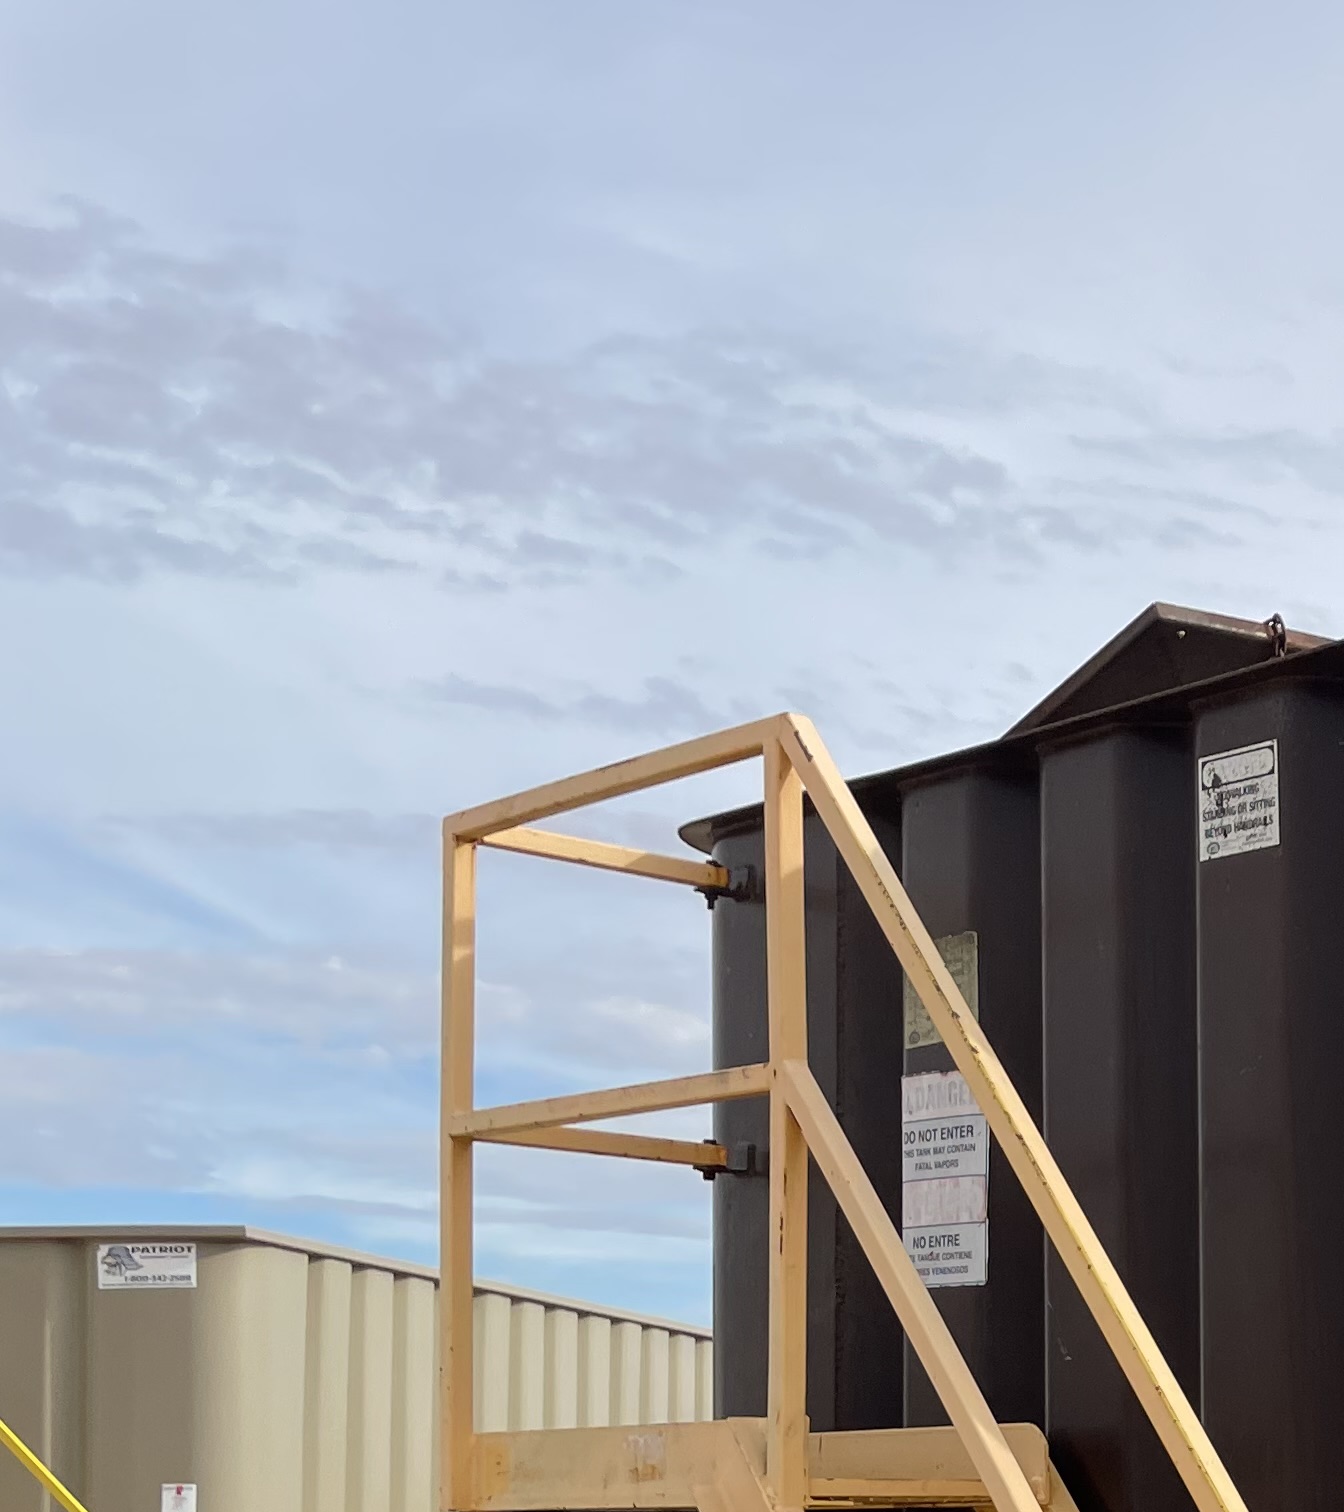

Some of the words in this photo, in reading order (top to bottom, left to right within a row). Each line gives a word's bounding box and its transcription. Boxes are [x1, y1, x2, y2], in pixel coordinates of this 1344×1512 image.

[904, 1131, 916, 1145] DO
[918, 1128, 938, 1143] NOT
[940, 1124, 974, 1140] ENTER
[933, 1145, 945, 1155] MAY
[947, 1143, 976, 1154] CONTAIN
[915, 1161, 932, 1171] FATAL
[934, 1159, 959, 1169] VAPORS
[912, 1236, 926, 1250] NO
[928, 1233, 960, 1249] ENTRE
[131, 1246, 194, 1254] PATRIOT
